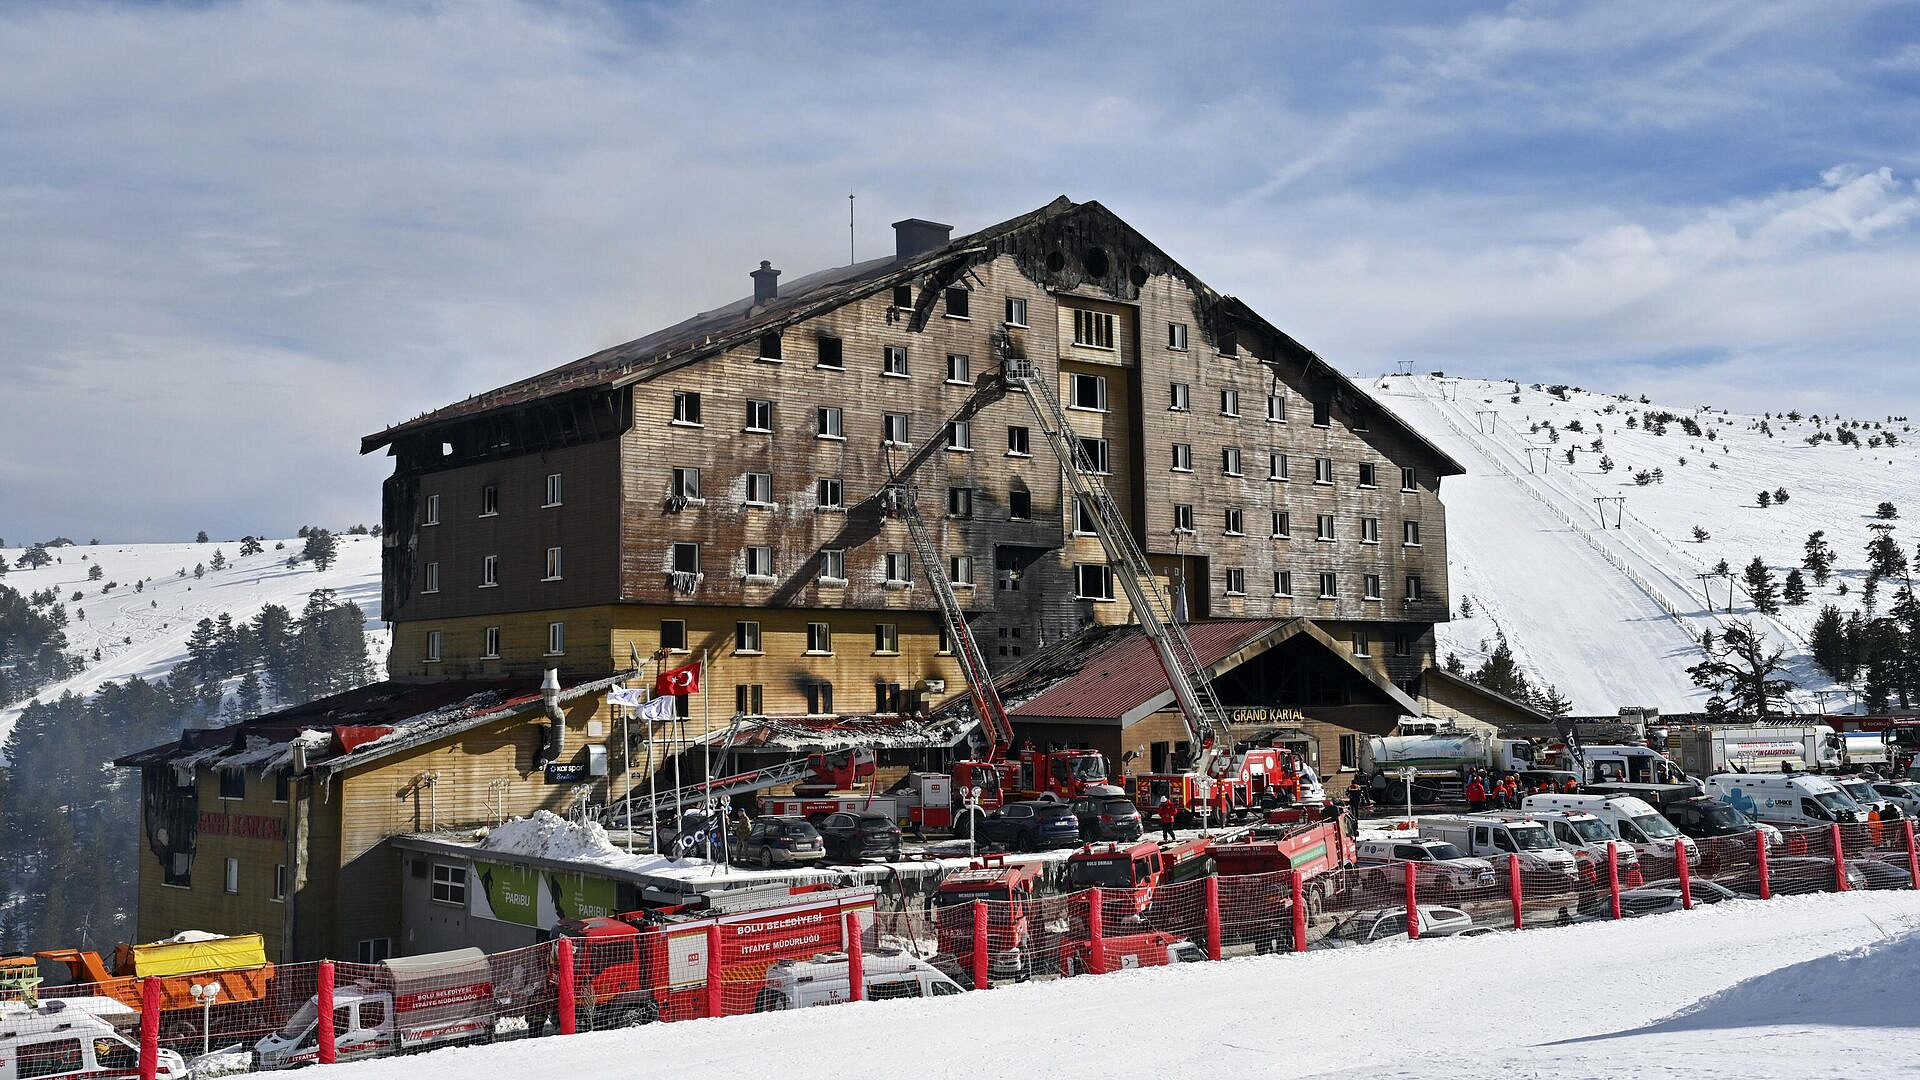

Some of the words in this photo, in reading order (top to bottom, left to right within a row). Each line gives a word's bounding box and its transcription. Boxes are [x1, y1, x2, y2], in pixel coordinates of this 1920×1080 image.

[1233, 709, 1267, 721] GRAND
[1269, 708, 1305, 720] KARTAL
[737, 923, 764, 935] BOLU
[766, 911, 822, 930] BELEDİYESİ
[741, 942, 771, 955] İTFAİYE
[773, 933, 820, 949] MÜDÜRLÜĞÜ
[417, 993, 435, 1001] BOLU
[292, 1053, 317, 1062] İTFAİYE
